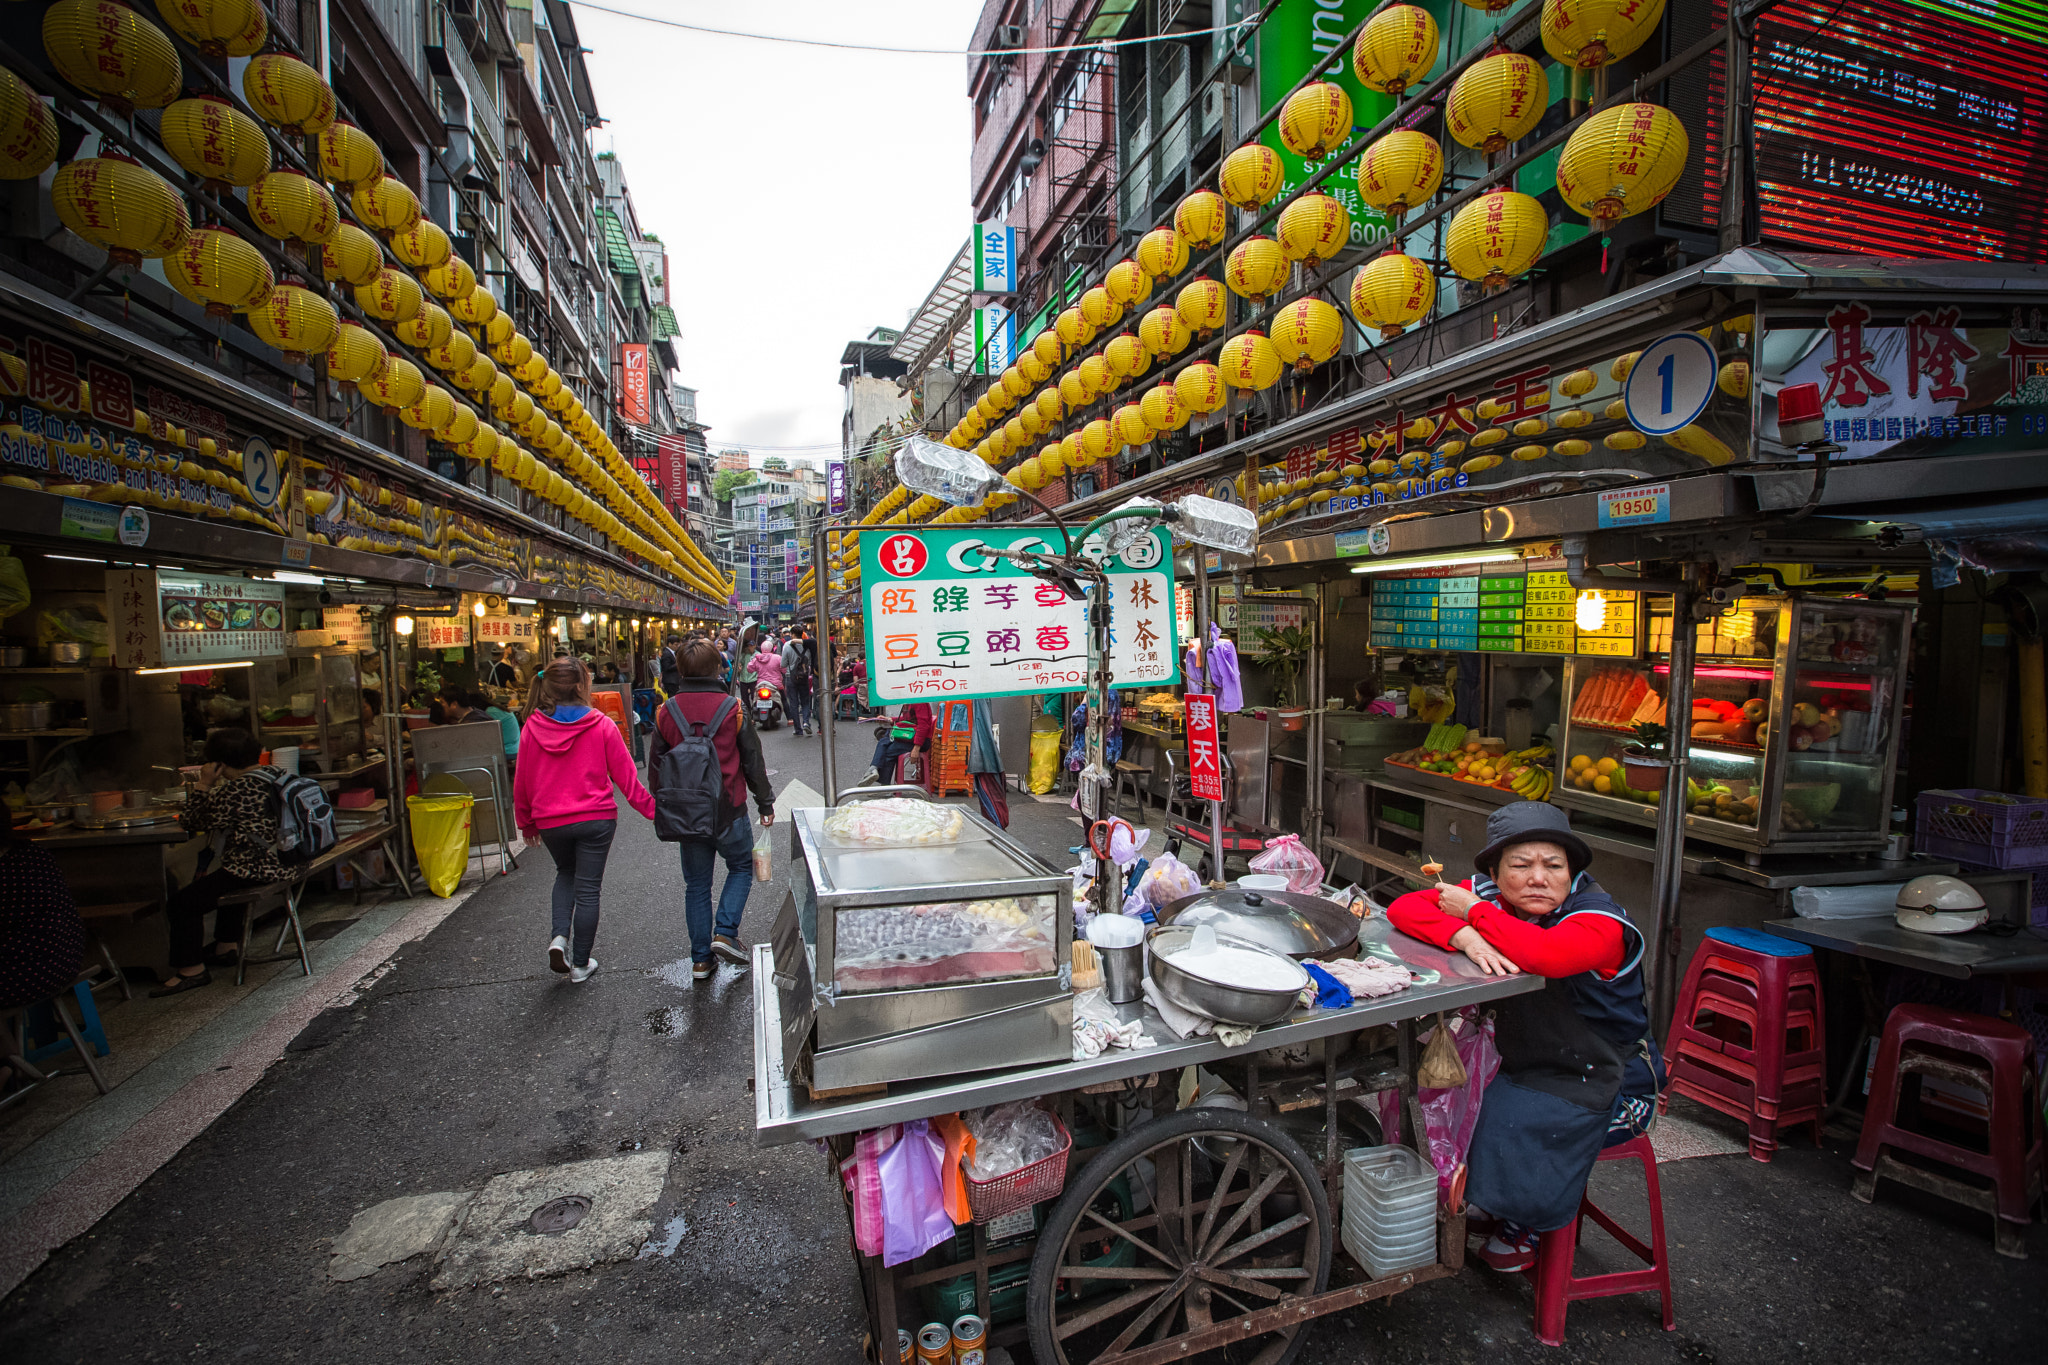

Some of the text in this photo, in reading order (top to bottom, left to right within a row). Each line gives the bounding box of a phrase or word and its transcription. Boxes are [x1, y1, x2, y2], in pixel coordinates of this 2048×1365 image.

[1504, 61, 1531, 119] 開漳聖王
[1304, 158, 1359, 180] STLE
[984, 231, 1005, 278] 全家
[990, 308, 1001, 370] FamilyMart
[1821, 300, 1981, 408] 基隆
[634, 370, 646, 417] COSMED
[1657, 353, 1675, 416] 1
[1284, 365, 1551, 483] 鮮果汁大王
[1, 431, 232, 515] Salted Vegetable and Pig's Blood Soup
[253, 449, 271, 495] 2
[324, 455, 409, 516] 米粉湯
[669, 452, 685, 503] Triumph
[1328, 471, 1469, 514] Fresh Juice
[1343, 450, 1446, 489] ジュース大王
[1614, 499, 1653, 515] 1950
[1528, 574, 1567, 585] 木瓜牛奶
[880, 587, 919, 660] 紅豆
[932, 585, 970, 656] 綠豆
[984, 584, 1021, 653] 芋頭
[1033, 583, 1071, 652] 草莓
[1129, 578, 1160, 651] 抹茶
[1526, 606, 1565, 617] 西瓜牛奶
[1579, 641, 1619, 652] 布丁牛奶
[890, 678, 969, 694] 一份50元
[1189, 699, 1216, 771] 寒天
